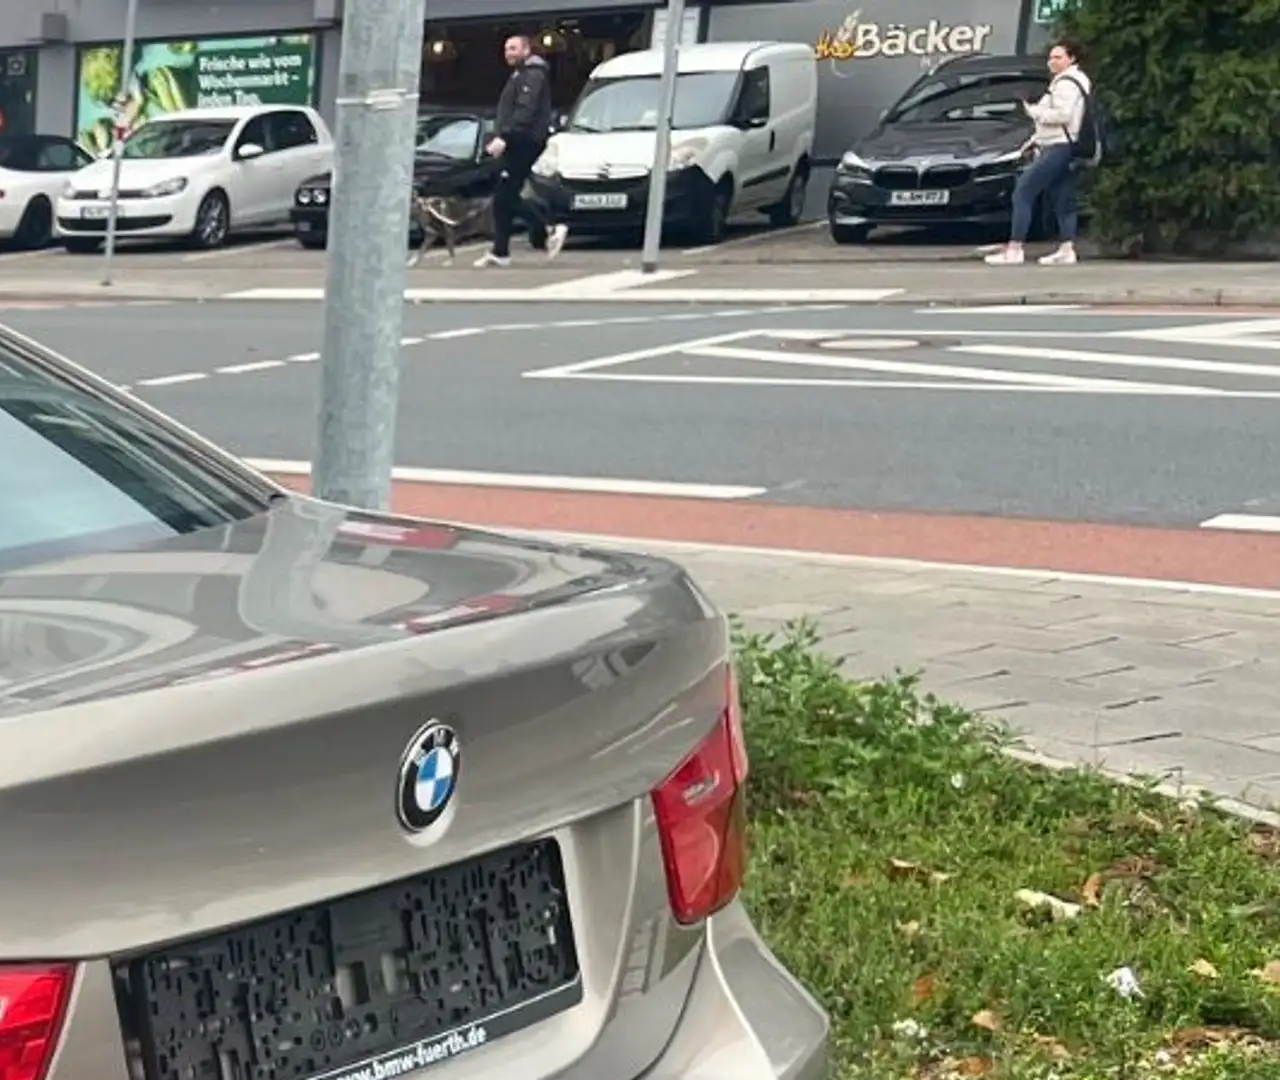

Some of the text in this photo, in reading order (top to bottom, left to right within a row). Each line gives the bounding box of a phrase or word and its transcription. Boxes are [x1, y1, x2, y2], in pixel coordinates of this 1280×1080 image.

[855, 20, 991, 56] Bäcker
[200, 53, 302, 71] Frische wie vom
[198, 70, 289, 90] Wochenmarkt
